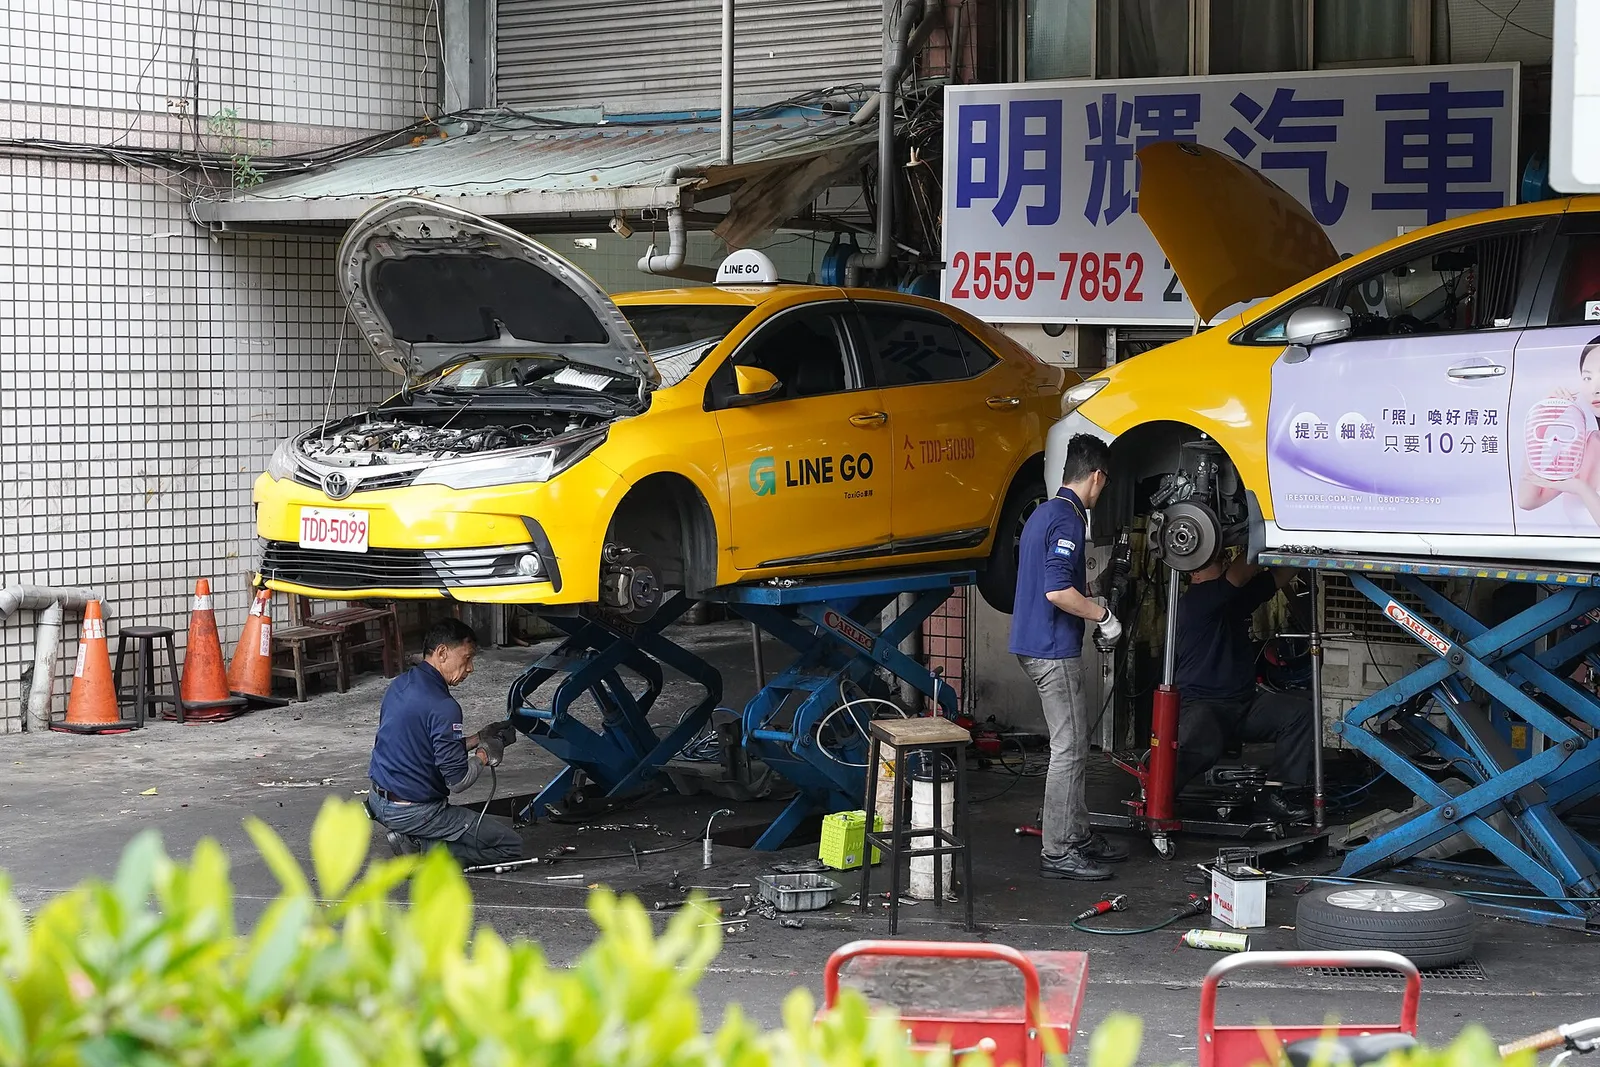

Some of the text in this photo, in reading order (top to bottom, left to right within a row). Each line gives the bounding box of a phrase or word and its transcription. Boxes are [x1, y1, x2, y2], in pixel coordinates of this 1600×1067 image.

[724, 264, 760, 275] LINE GO
[951, 251, 1145, 303] 2559-7852
[1295, 422, 1376, 440] 提亮 細緻
[1384, 432, 1499, 455] 只要10分鐘
[918, 436, 976, 464] TDD-5099
[785, 452, 874, 488] LINE GO
[1378, 496, 1441, 505] 0800-252-590
[1387, 605, 1448, 652] CARLEO
